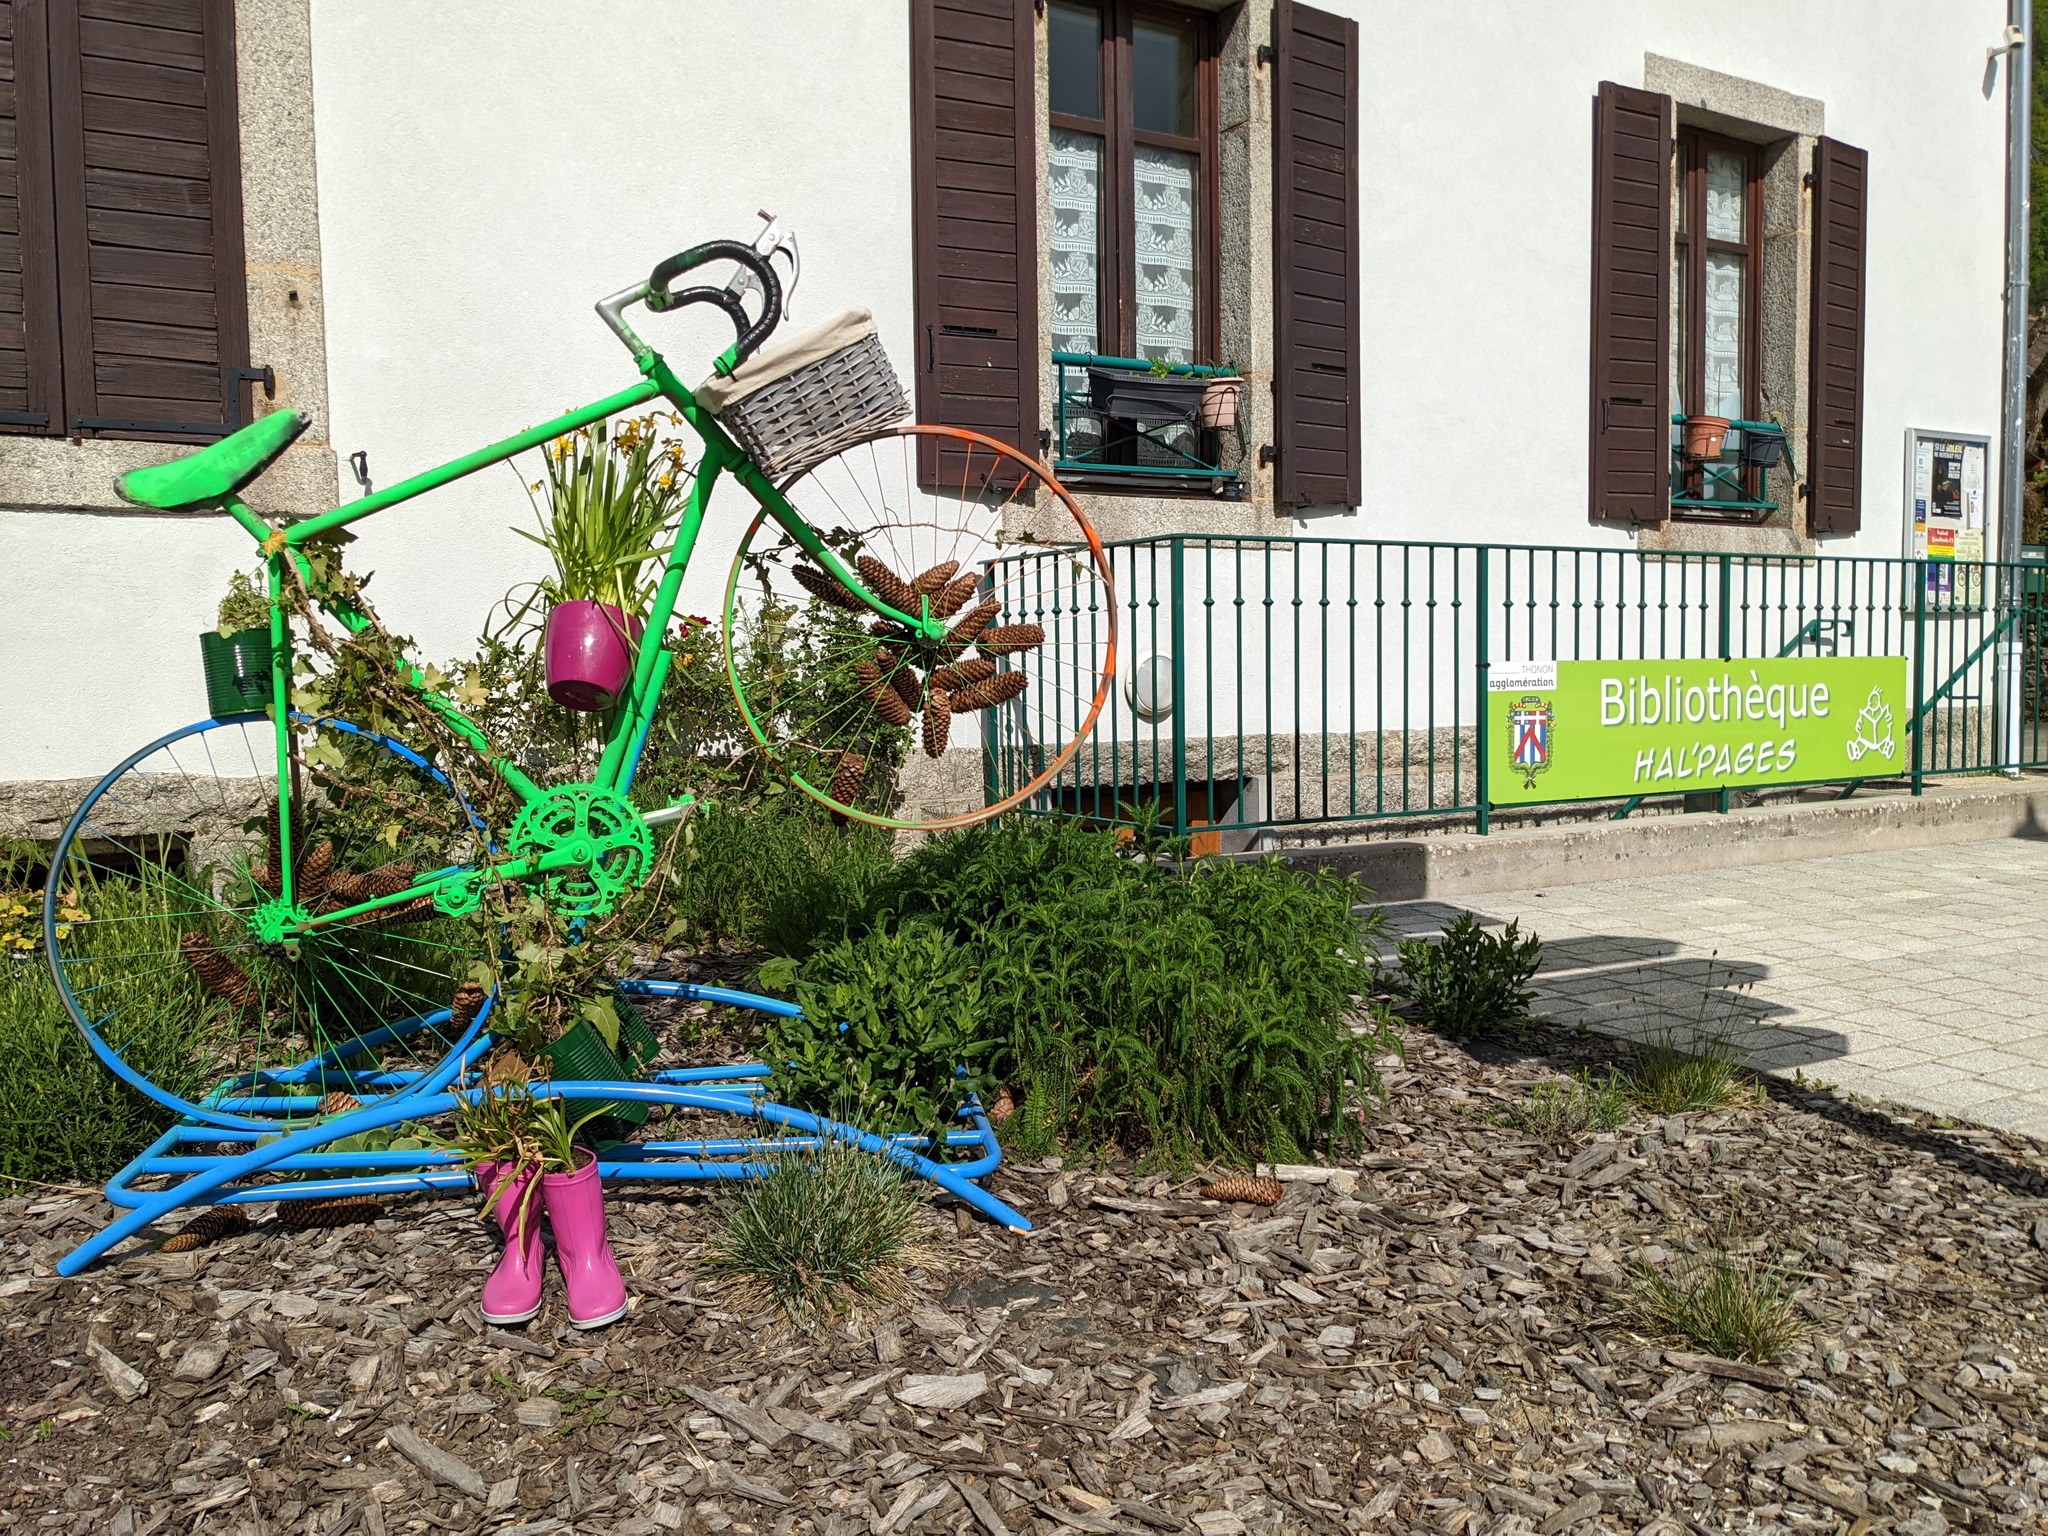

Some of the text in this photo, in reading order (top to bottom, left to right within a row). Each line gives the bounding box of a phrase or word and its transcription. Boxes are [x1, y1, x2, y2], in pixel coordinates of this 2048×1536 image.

[1934, 443, 1963, 453] SI LE SOLEIL
[1521, 665, 1554, 674] THONON
[1489, 677, 1555, 690] agglomération
[1600, 670, 1831, 730] Bibliothèque
[1633, 739, 1797, 782] HAL'PAGES
